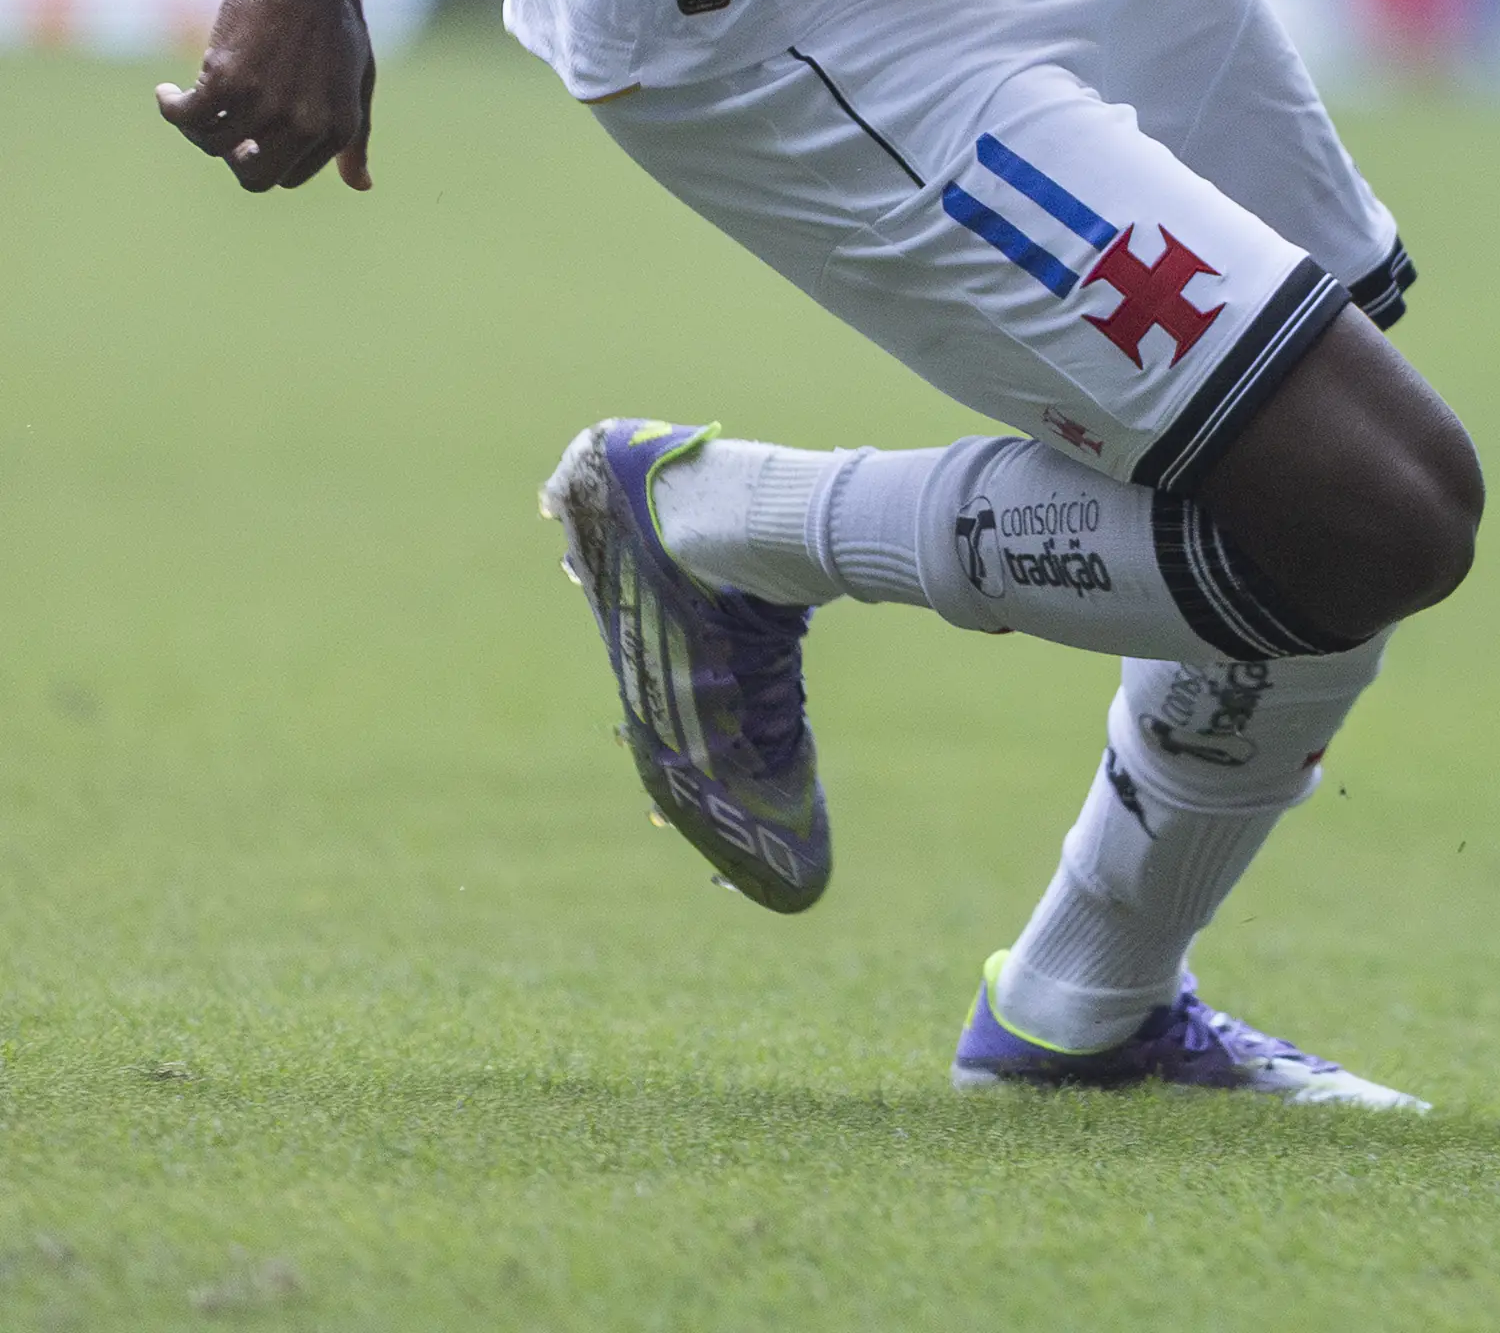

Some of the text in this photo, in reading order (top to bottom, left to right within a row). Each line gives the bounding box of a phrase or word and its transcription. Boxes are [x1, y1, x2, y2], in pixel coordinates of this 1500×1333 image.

[942, 133, 1118, 300] 11
[1001, 491, 1100, 537] consórcio
[1003, 538, 1112, 599] tradição
